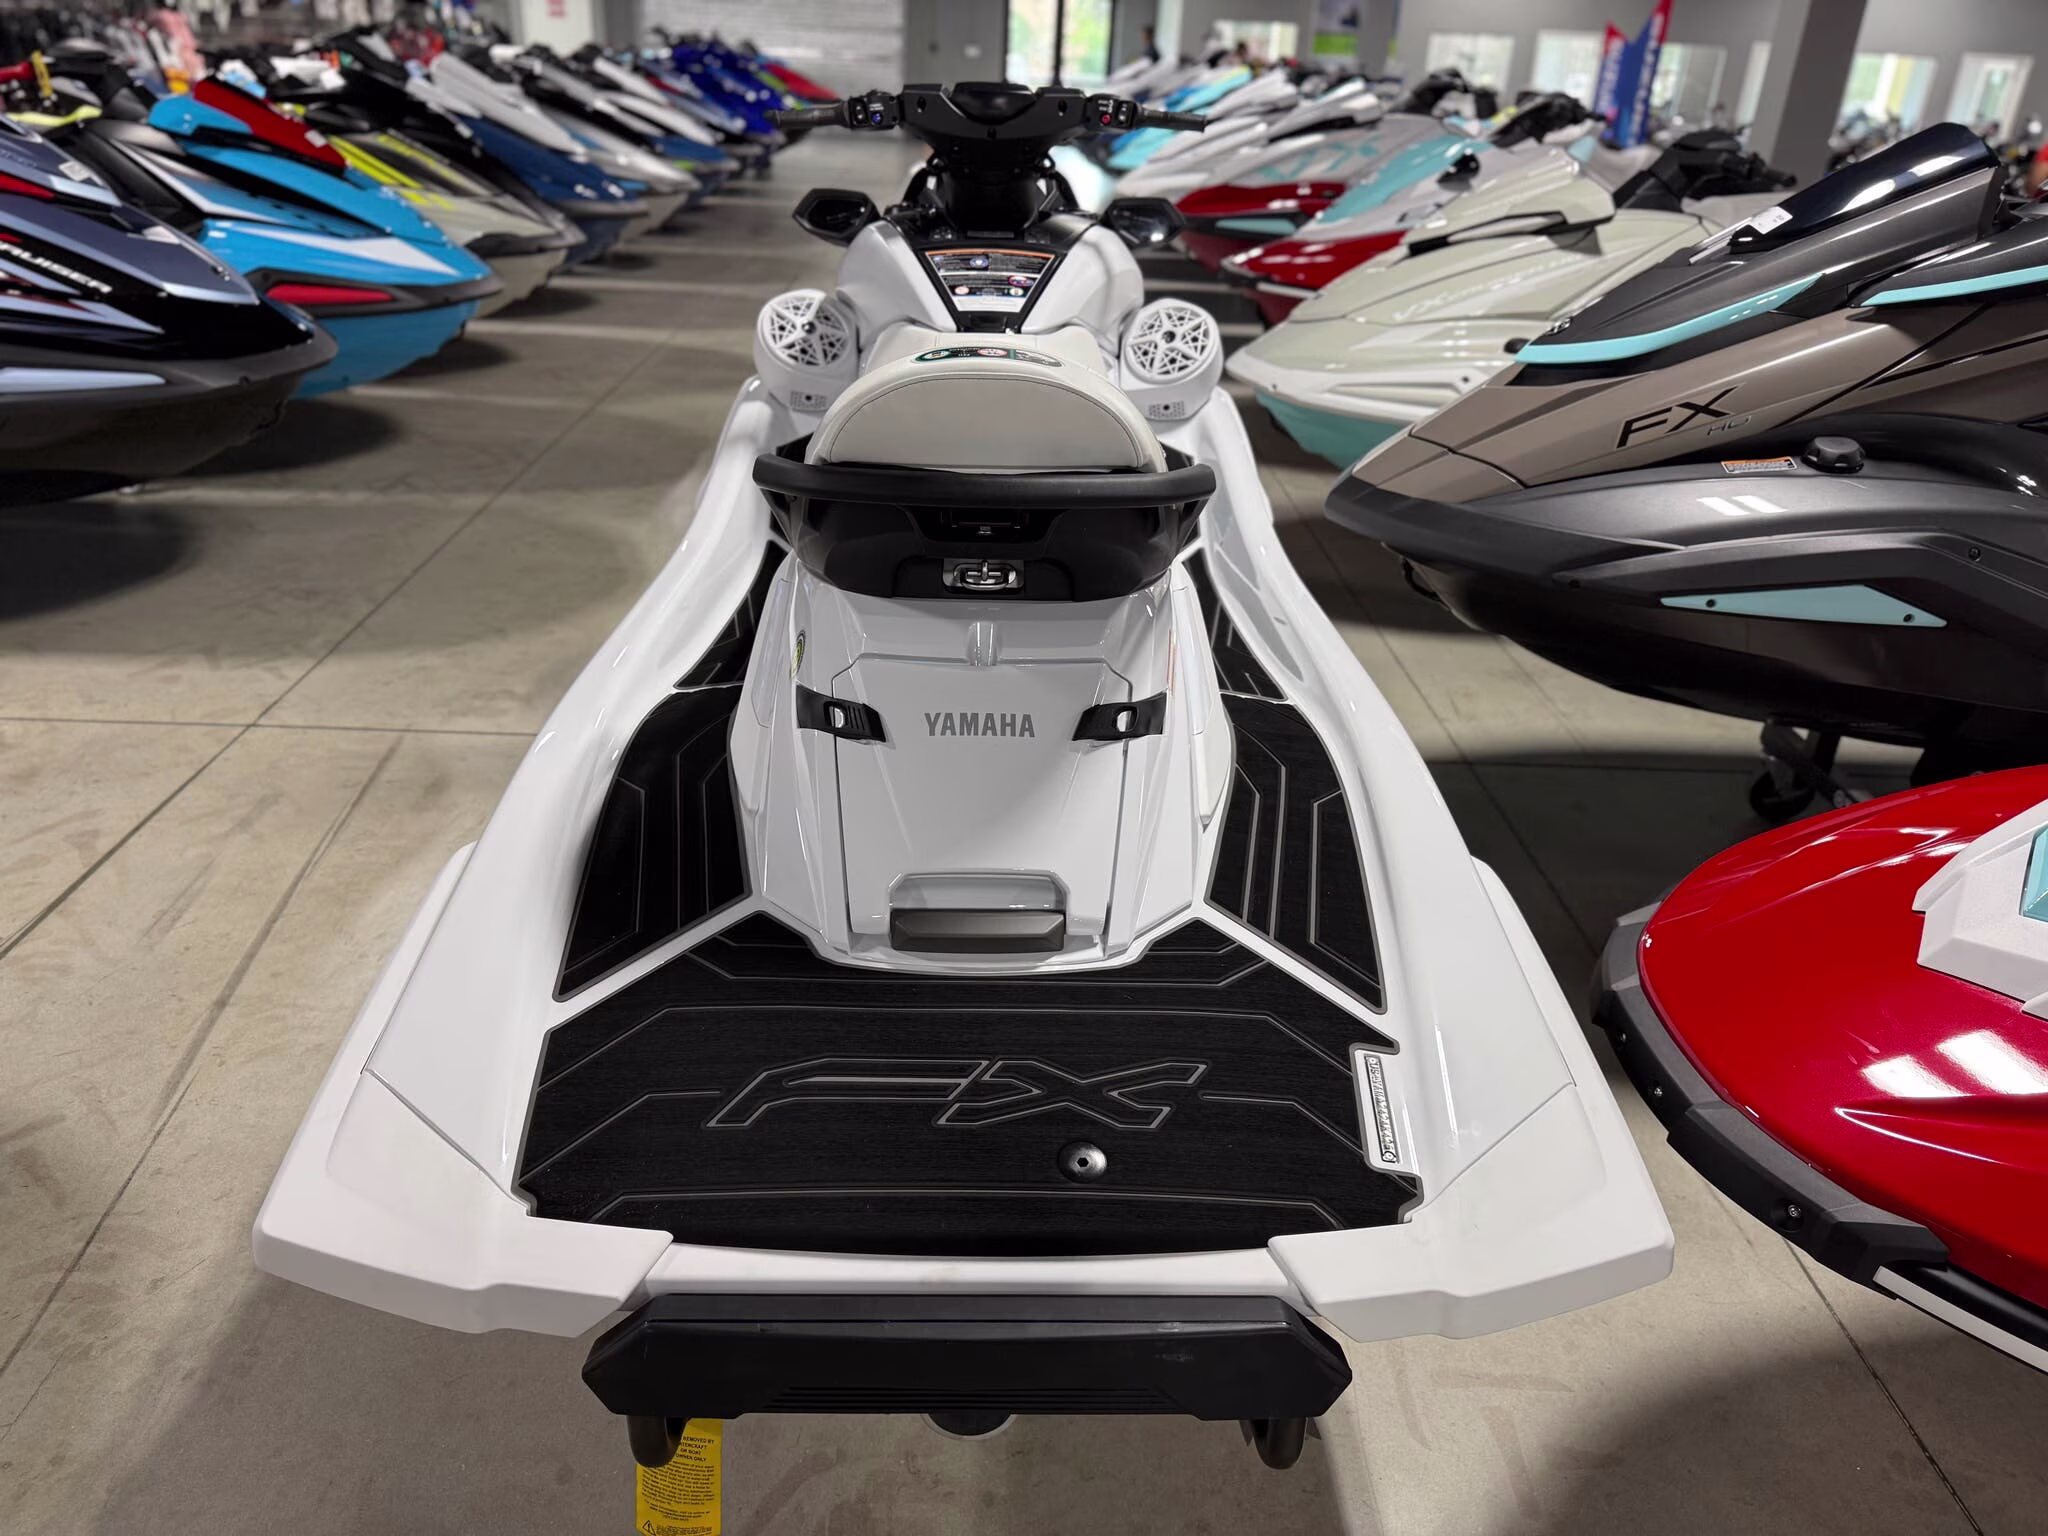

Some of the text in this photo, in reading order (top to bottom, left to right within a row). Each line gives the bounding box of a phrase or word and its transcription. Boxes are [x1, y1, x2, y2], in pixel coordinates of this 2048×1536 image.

[1614, 383, 1741, 449] FX
[924, 712, 1035, 738] YAMAHA
[706, 1057, 1208, 1129] FX
